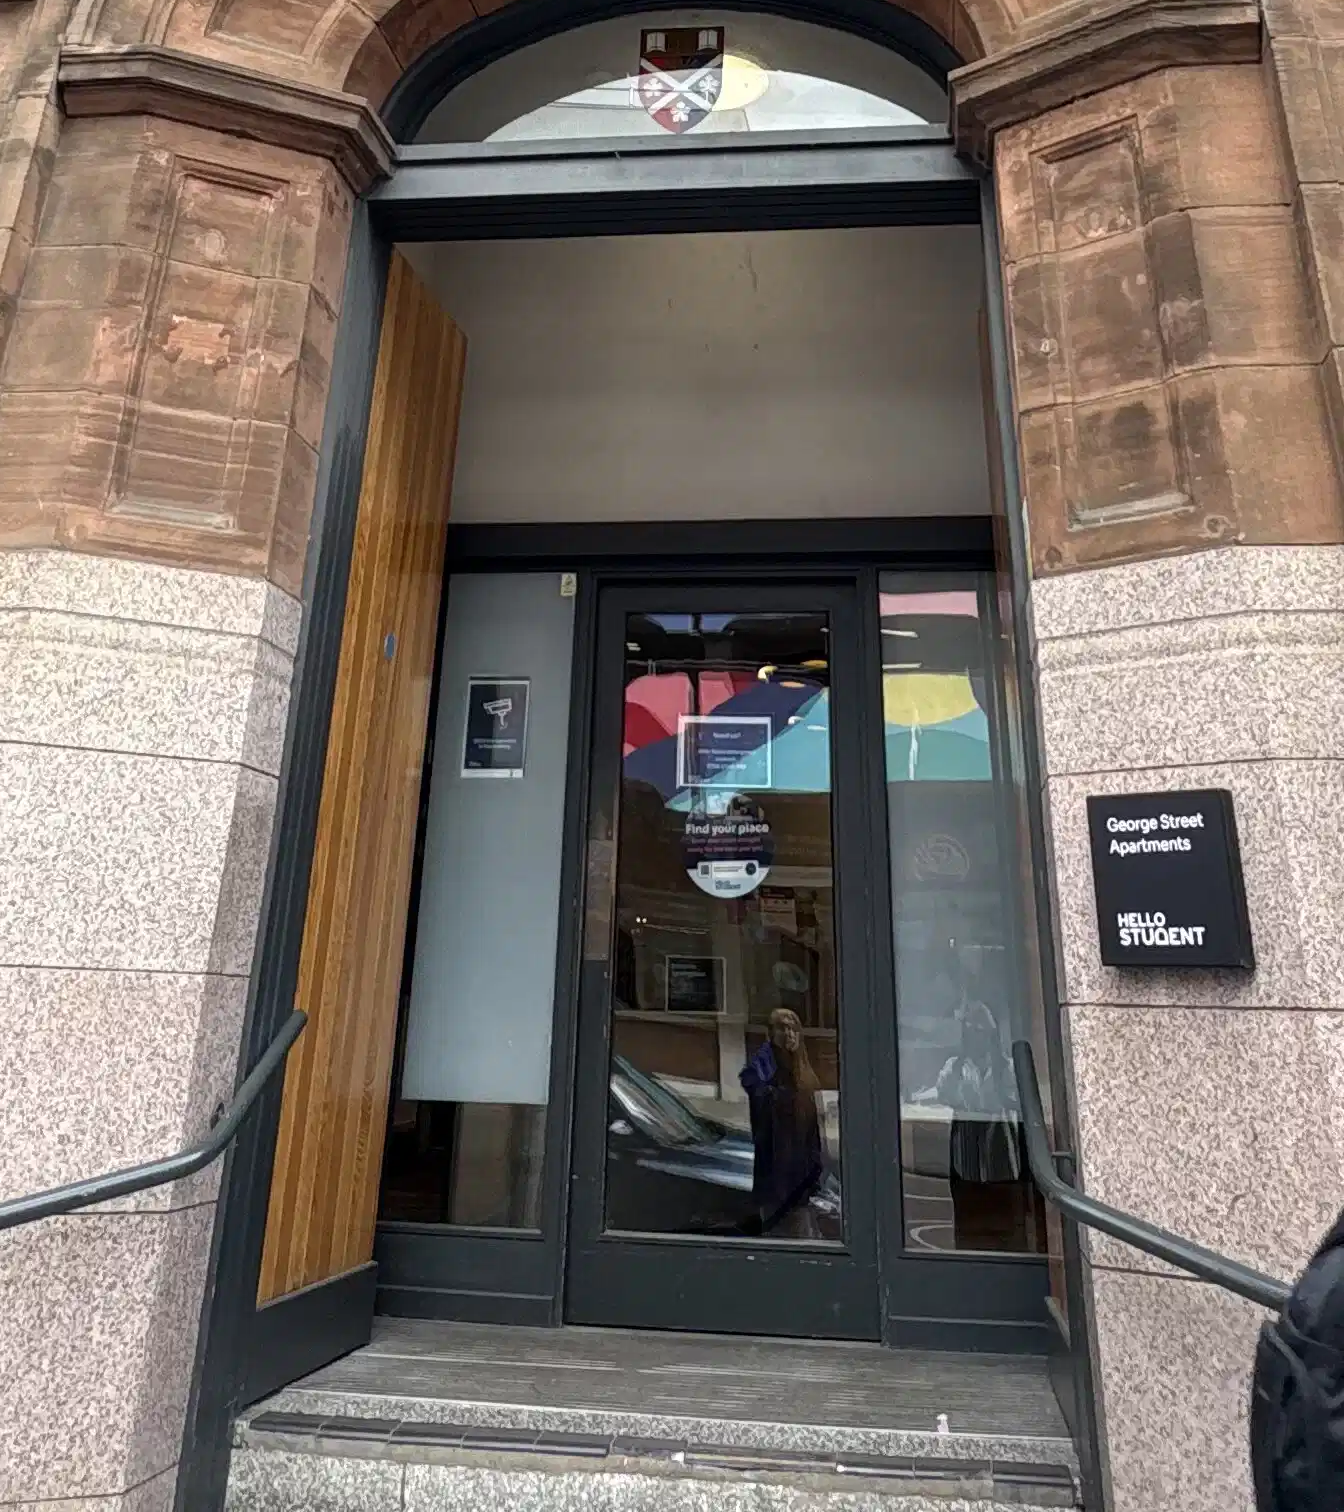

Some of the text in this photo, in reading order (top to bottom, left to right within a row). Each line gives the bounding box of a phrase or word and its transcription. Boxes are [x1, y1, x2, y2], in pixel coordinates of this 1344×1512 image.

[685, 821, 770, 837] Find your place
[1106, 812, 1205, 834] George Street
[1109, 836, 1192, 857] Apartments
[1117, 912, 1166, 928] HELLO
[1119, 926, 1206, 946] STUDENT
